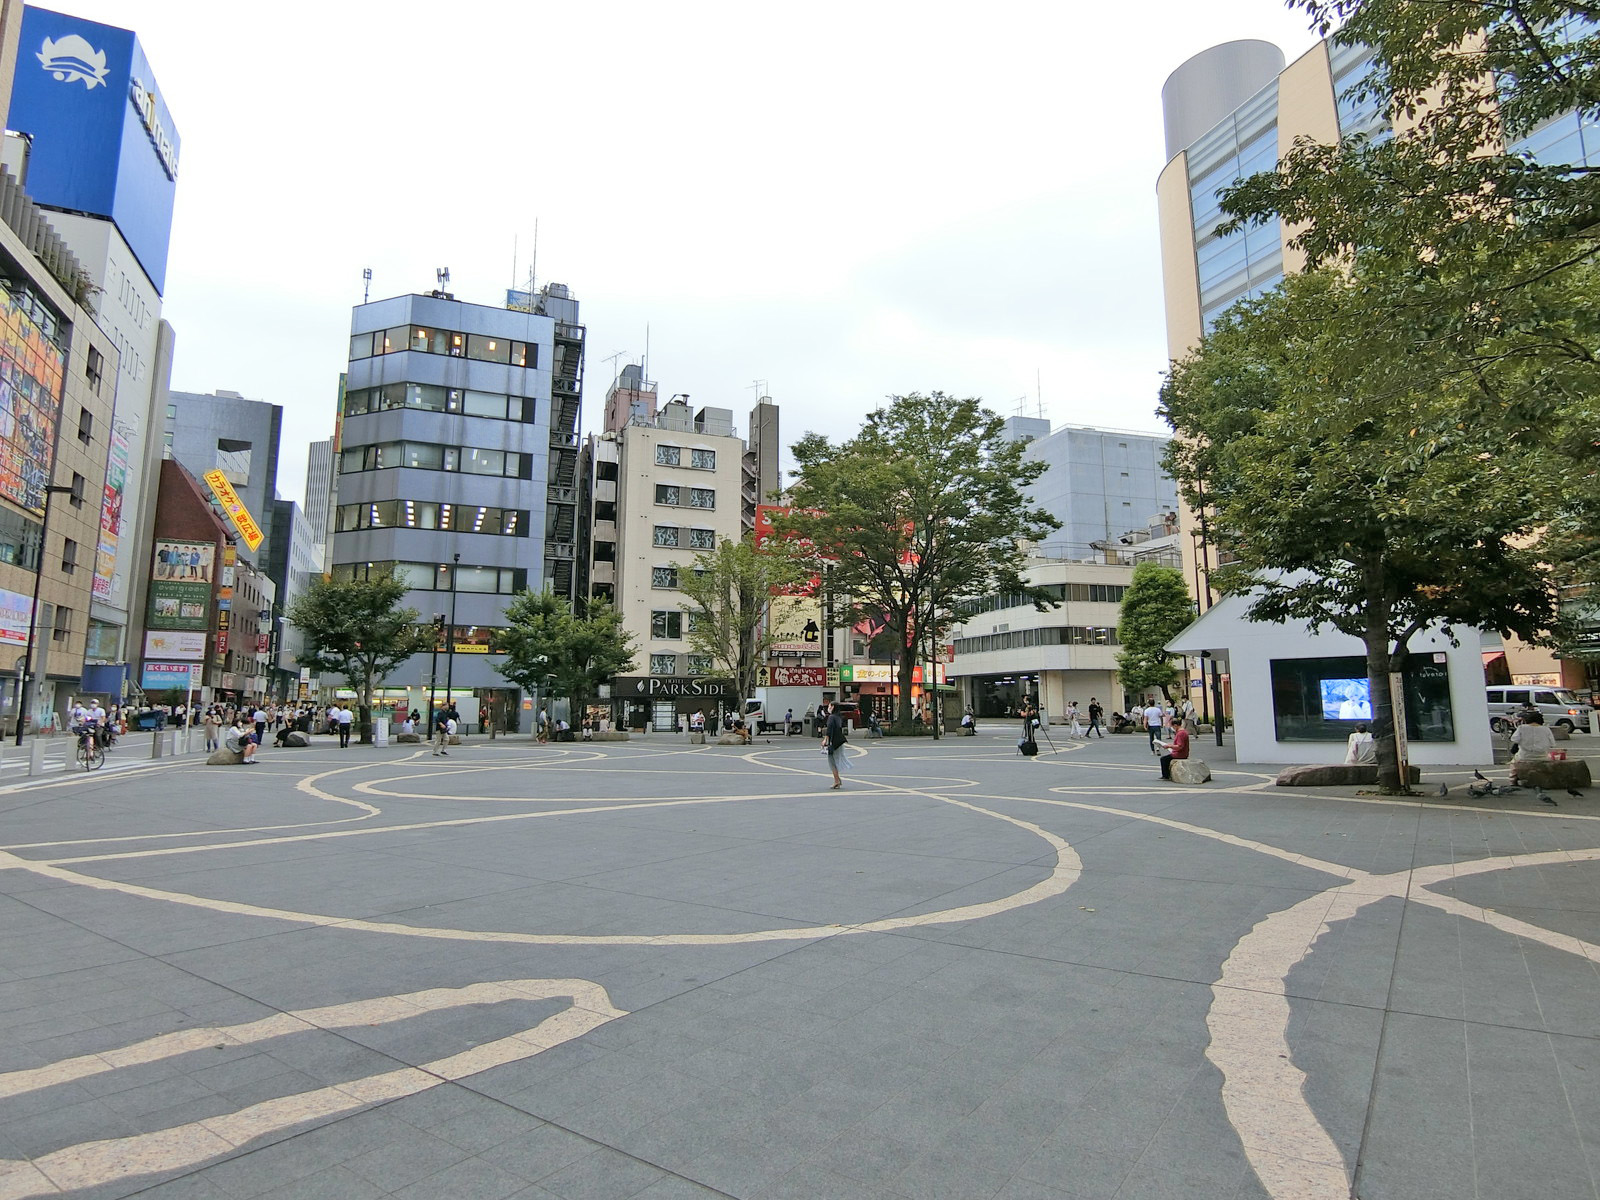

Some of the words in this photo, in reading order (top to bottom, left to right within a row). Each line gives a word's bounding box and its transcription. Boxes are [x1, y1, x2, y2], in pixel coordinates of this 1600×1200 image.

[209, 474, 235, 504] カラオケ
[236, 513, 260, 541] 歌広場
[158, 584, 206, 594] evergreen
[775, 667, 818, 686] 俺んち来い
